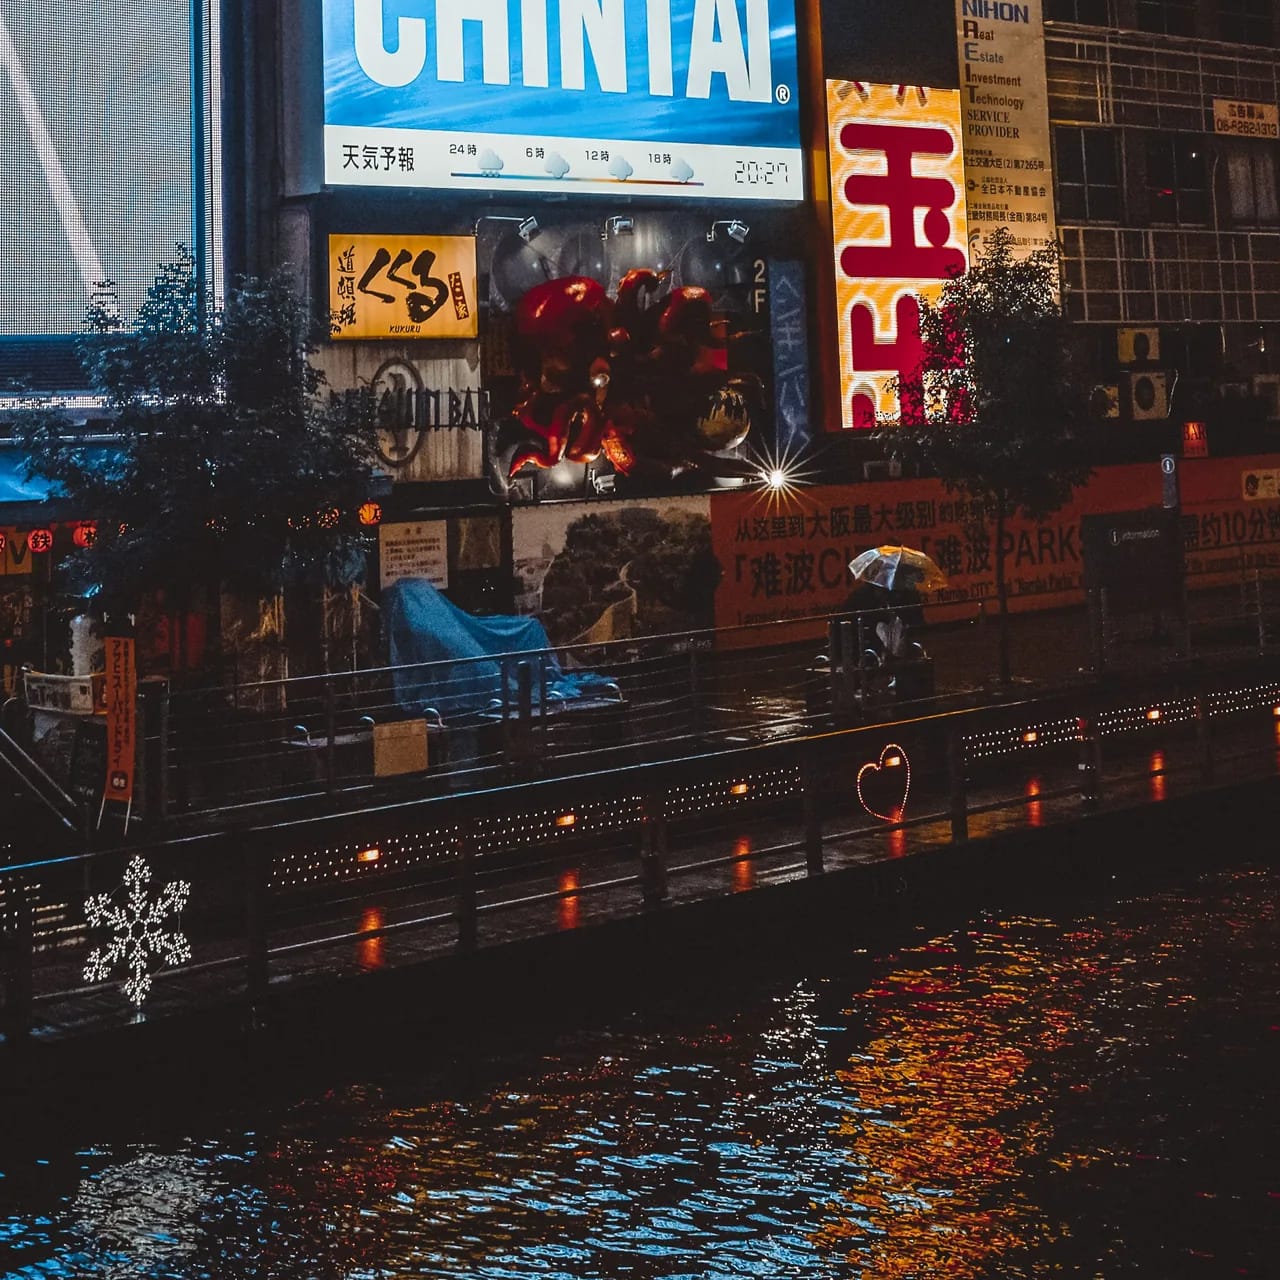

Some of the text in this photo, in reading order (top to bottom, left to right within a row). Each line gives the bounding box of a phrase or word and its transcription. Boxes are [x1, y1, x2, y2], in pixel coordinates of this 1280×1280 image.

[964, 20, 995, 41] Real
[965, 42, 1005, 65] Estate
[965, 64, 1022, 87] Investment
[965, 85, 1025, 111] Technology
[967, 109, 1010, 124] SERVICE
[968, 124, 1020, 139] PROVIDER
[342, 143, 415, 174] 天気予報
[357, 247, 449, 323] くくる
[389, 325, 421, 334] KUKURU
